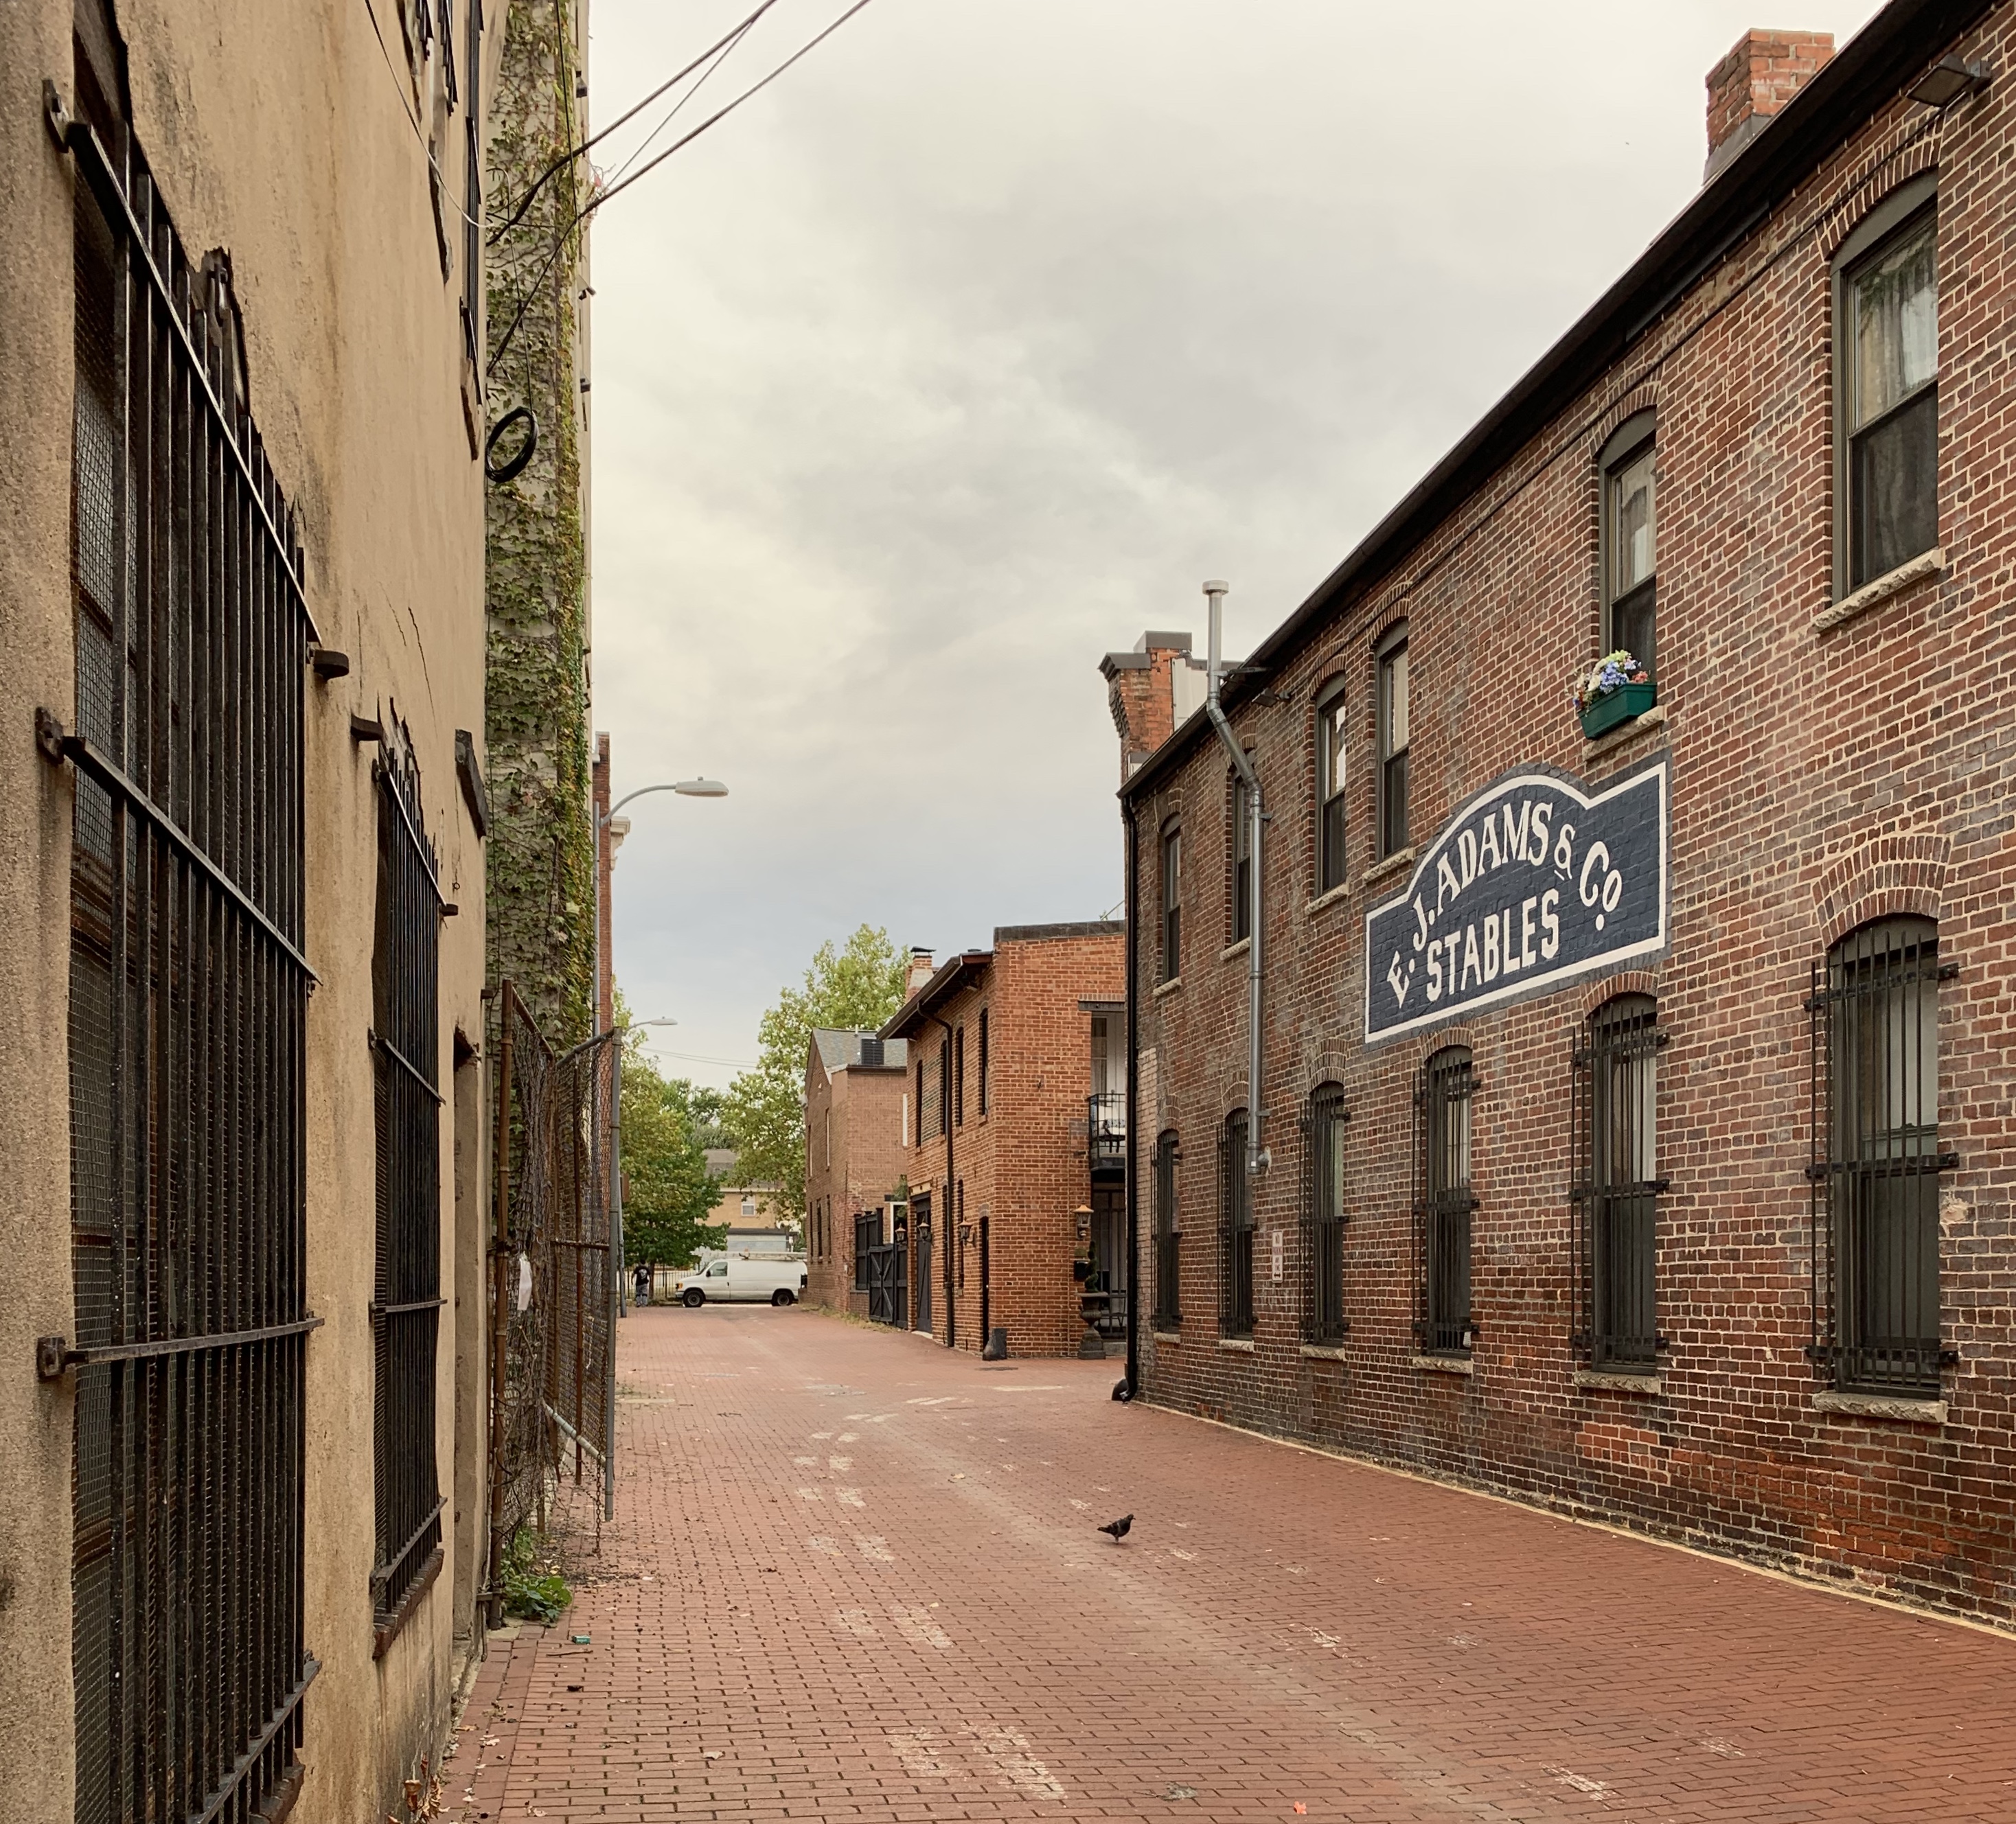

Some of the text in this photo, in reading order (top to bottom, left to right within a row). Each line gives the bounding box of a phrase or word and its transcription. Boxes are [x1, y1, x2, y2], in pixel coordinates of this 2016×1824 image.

[1387, 951, 1414, 1009] E.
[1412, 892, 1434, 951] J.
[1437, 800, 1553, 916] ADAMS
[1555, 823, 1576, 880] &
[1426, 888, 1559, 1002] STABLES
